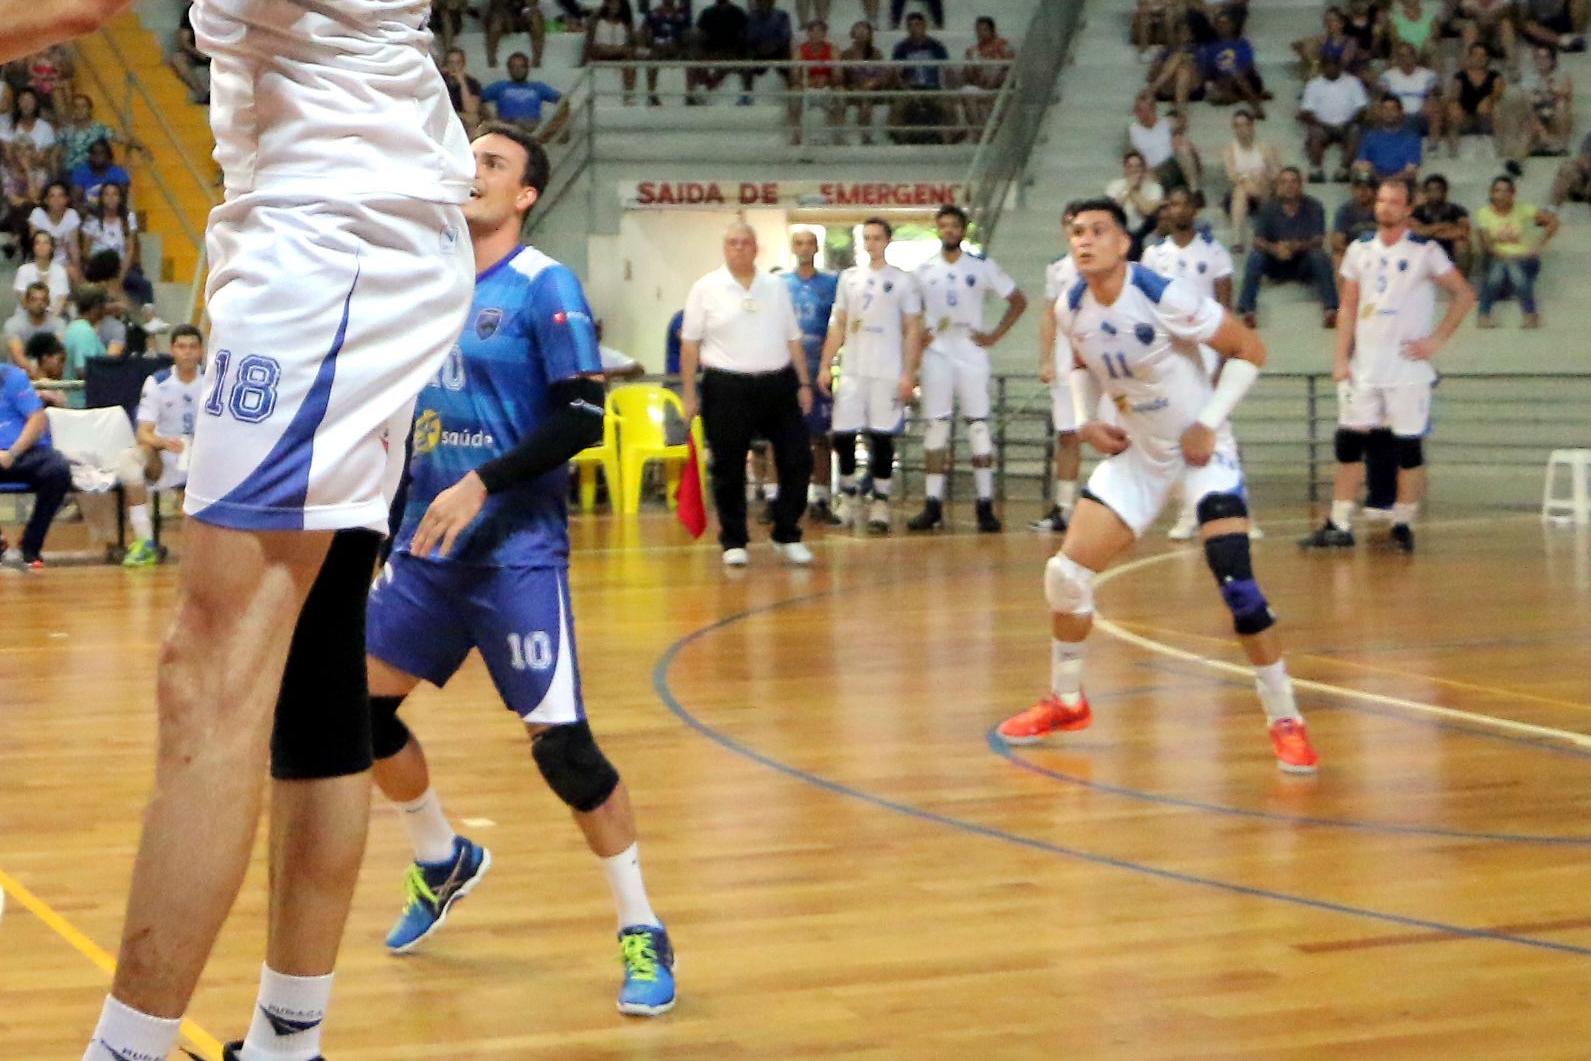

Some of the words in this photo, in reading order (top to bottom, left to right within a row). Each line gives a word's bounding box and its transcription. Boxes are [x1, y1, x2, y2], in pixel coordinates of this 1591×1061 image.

[637, 182, 725, 204] SAIDA
[739, 183, 778, 204] DE
[205, 349, 282, 424] 18
[441, 428, 495, 447] saúde
[506, 630, 553, 670] 10
